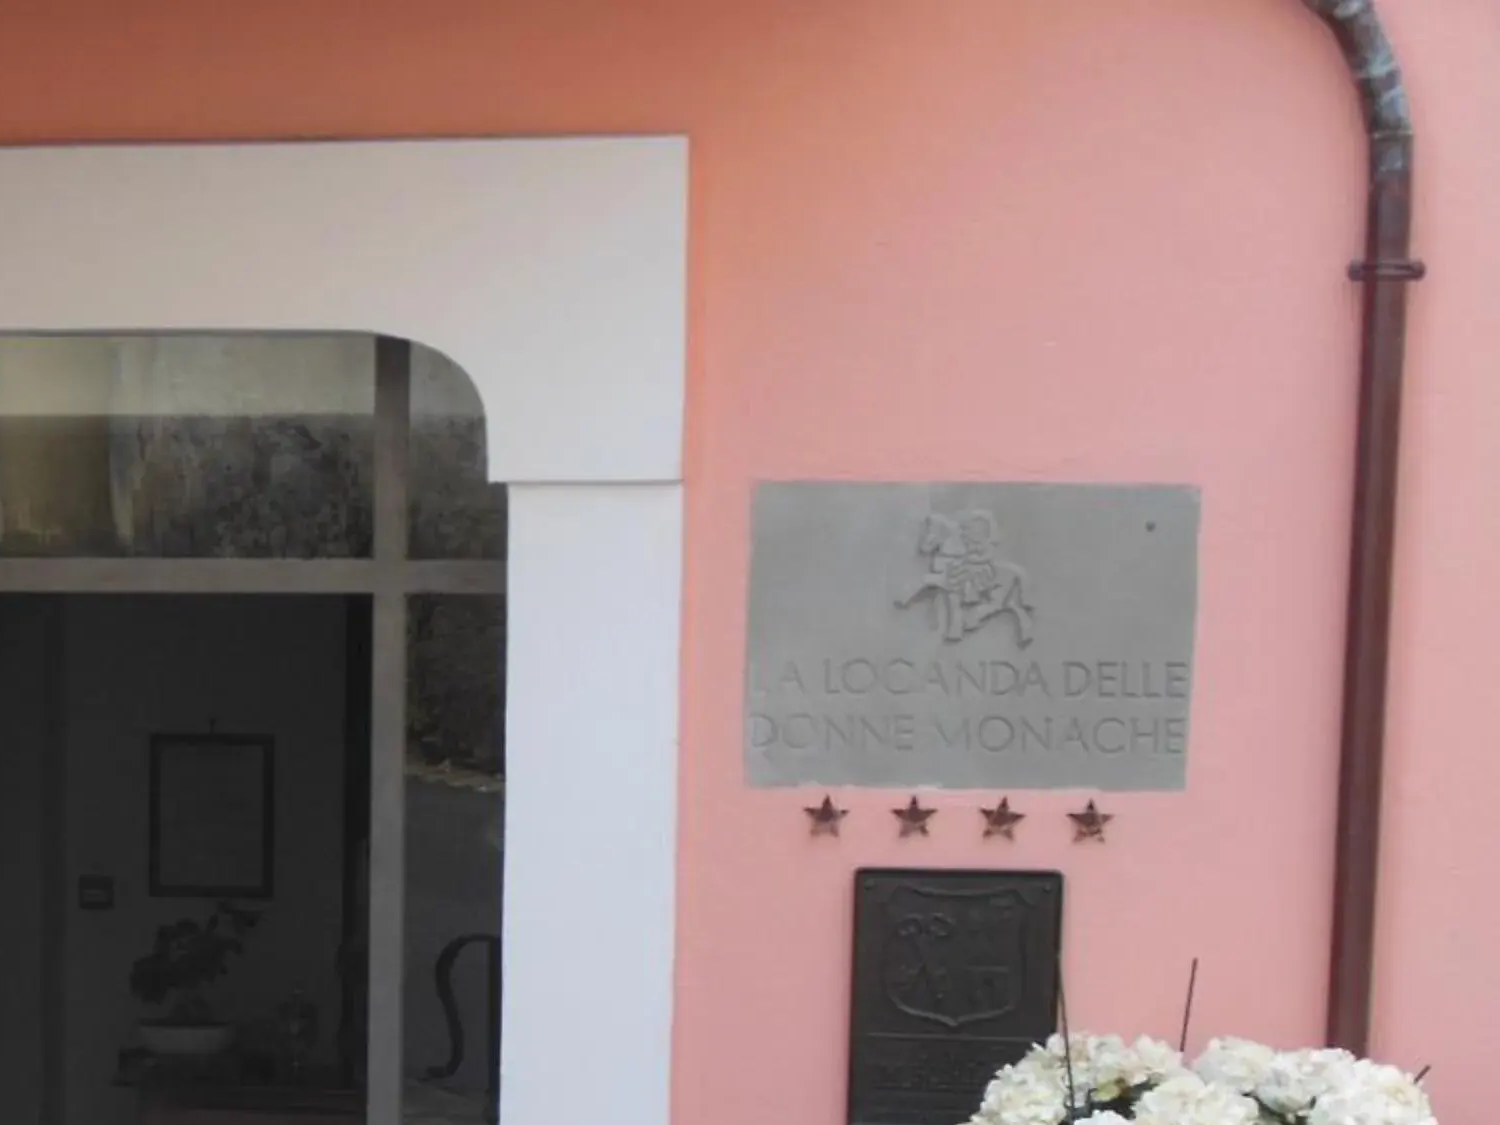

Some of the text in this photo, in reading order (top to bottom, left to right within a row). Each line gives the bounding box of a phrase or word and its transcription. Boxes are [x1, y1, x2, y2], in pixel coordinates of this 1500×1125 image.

[823, 656, 1052, 698] LOCANDA
[1062, 660, 1188, 698] DELLE
[748, 711, 1186, 755] DONNE MONACHE
